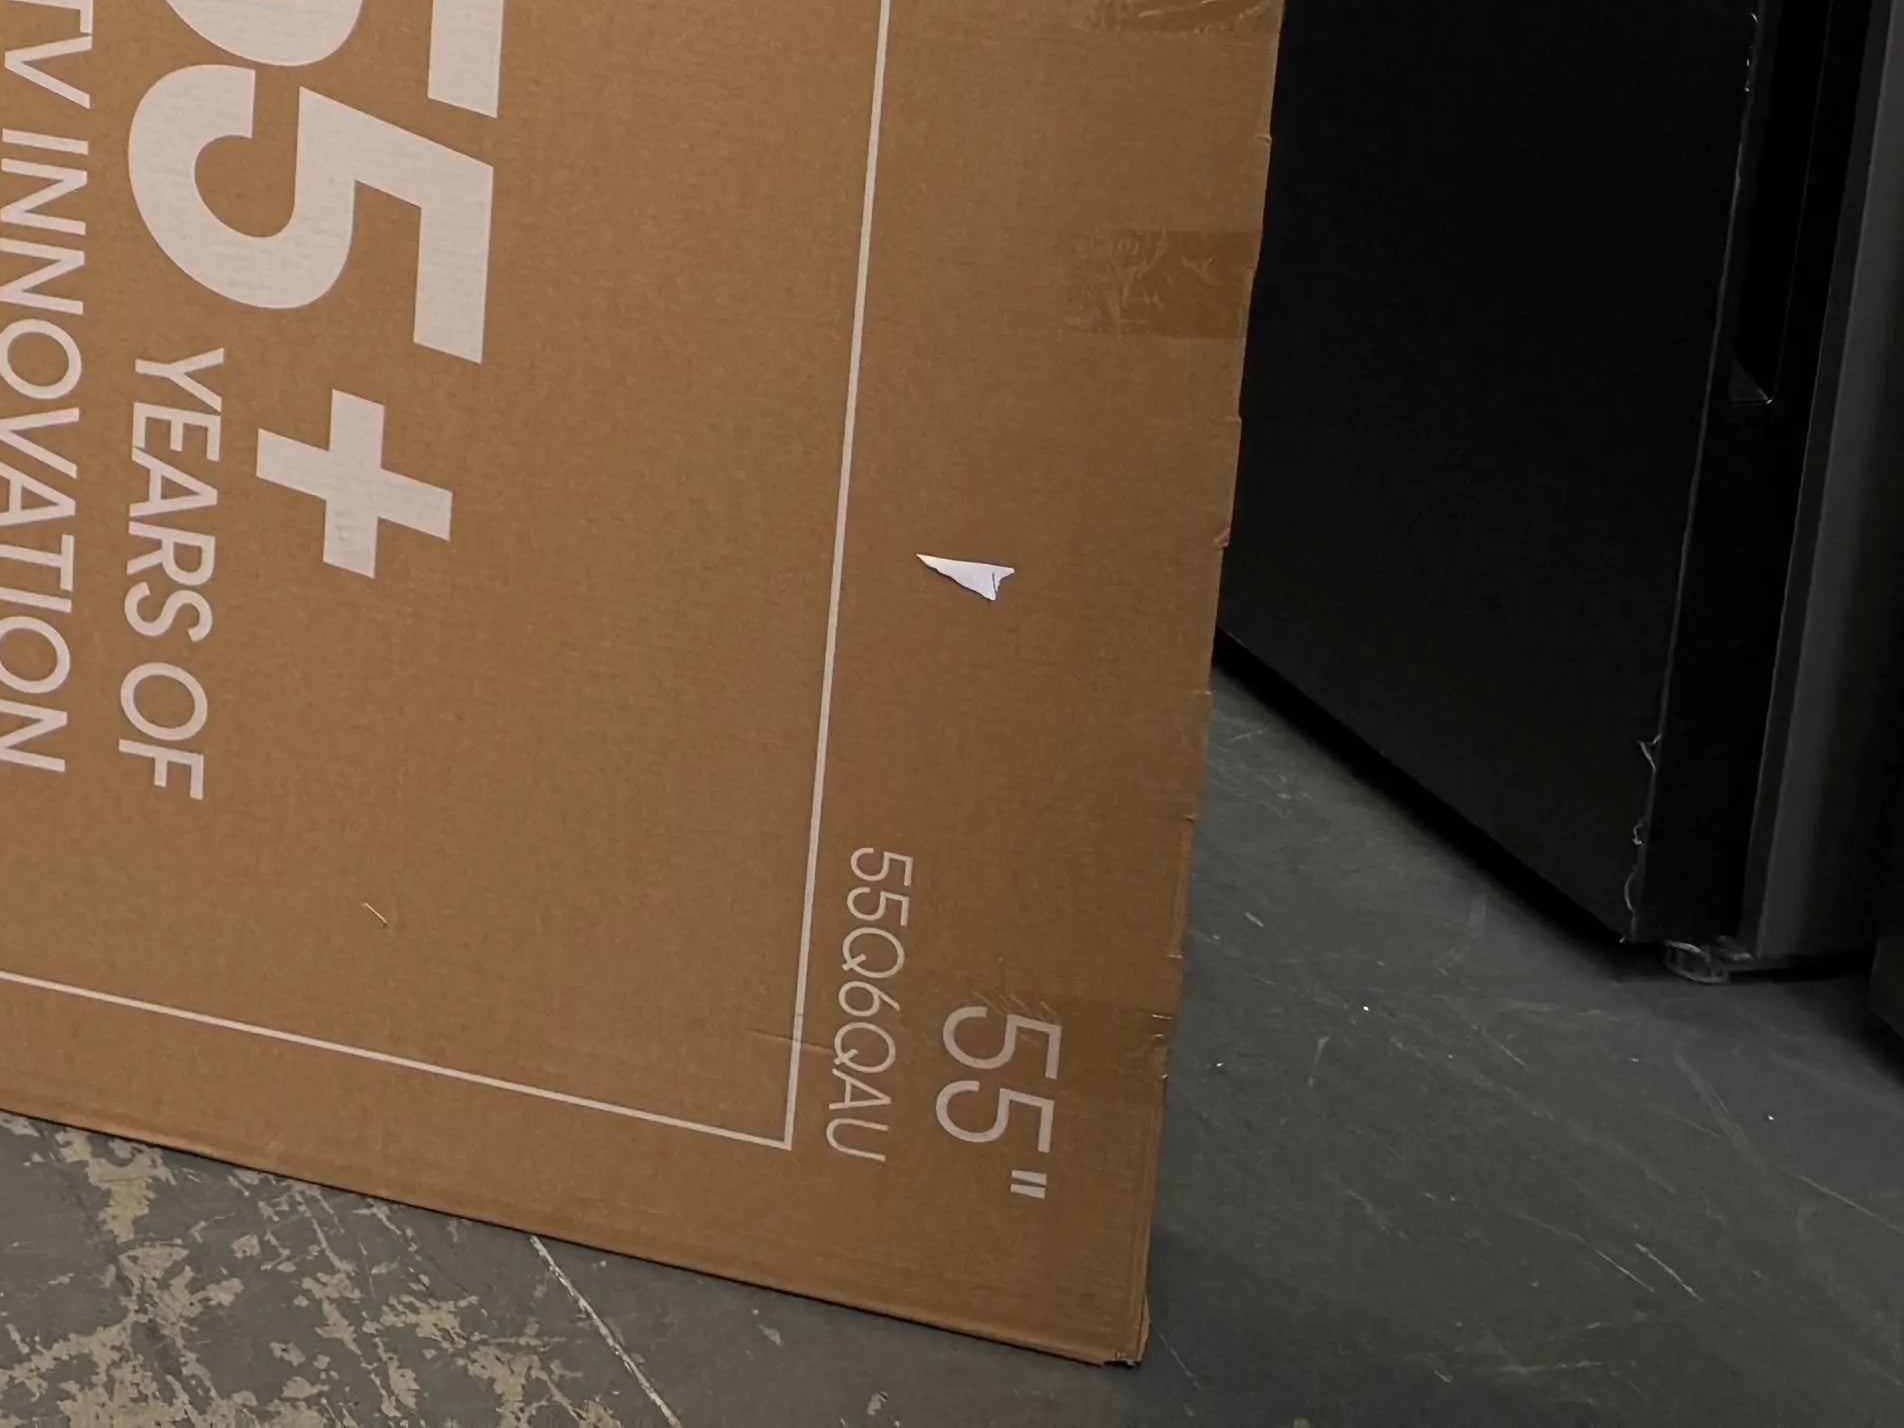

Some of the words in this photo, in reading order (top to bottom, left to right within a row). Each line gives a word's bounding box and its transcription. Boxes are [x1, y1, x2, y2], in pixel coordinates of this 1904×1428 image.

[122, 346, 228, 646] YEARS
[117, 659, 210, 802] OF
[825, 846, 915, 1163] 55Q6QAU
[934, 1006, 1064, 1200] 55"
